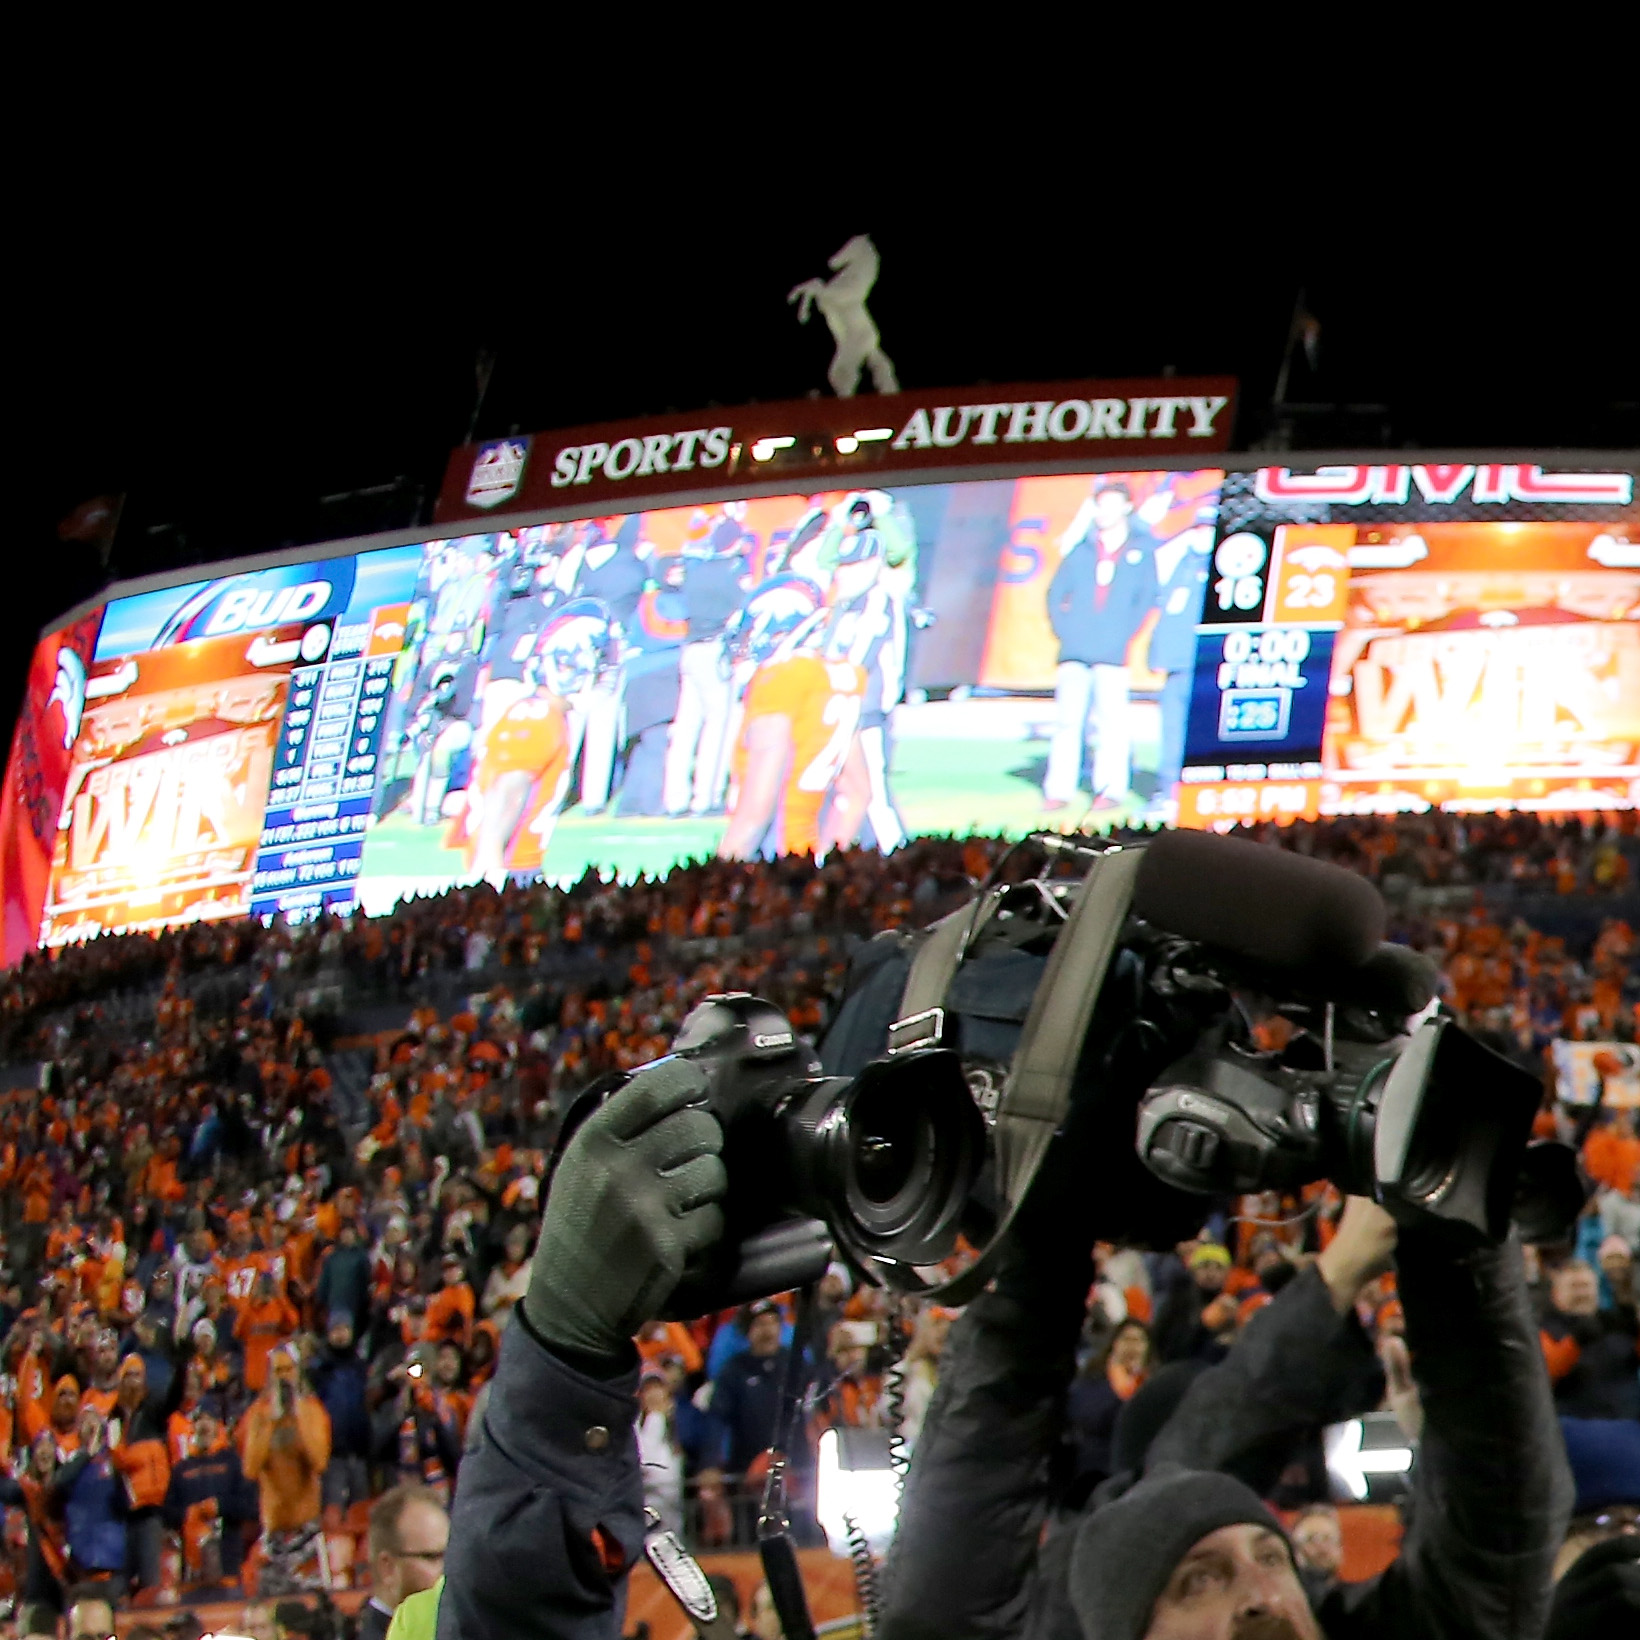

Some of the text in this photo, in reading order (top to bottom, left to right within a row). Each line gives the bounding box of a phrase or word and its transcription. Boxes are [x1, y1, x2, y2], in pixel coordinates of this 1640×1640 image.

[550, 427, 733, 488] SPORTS
[891, 396, 1228, 449] AUTHORITY
[205, 578, 334, 636] BUD
[1214, 573, 1335, 611] 16 23
[1222, 629, 1311, 665] 0:00
[1216, 660, 1309, 691] FINAL
